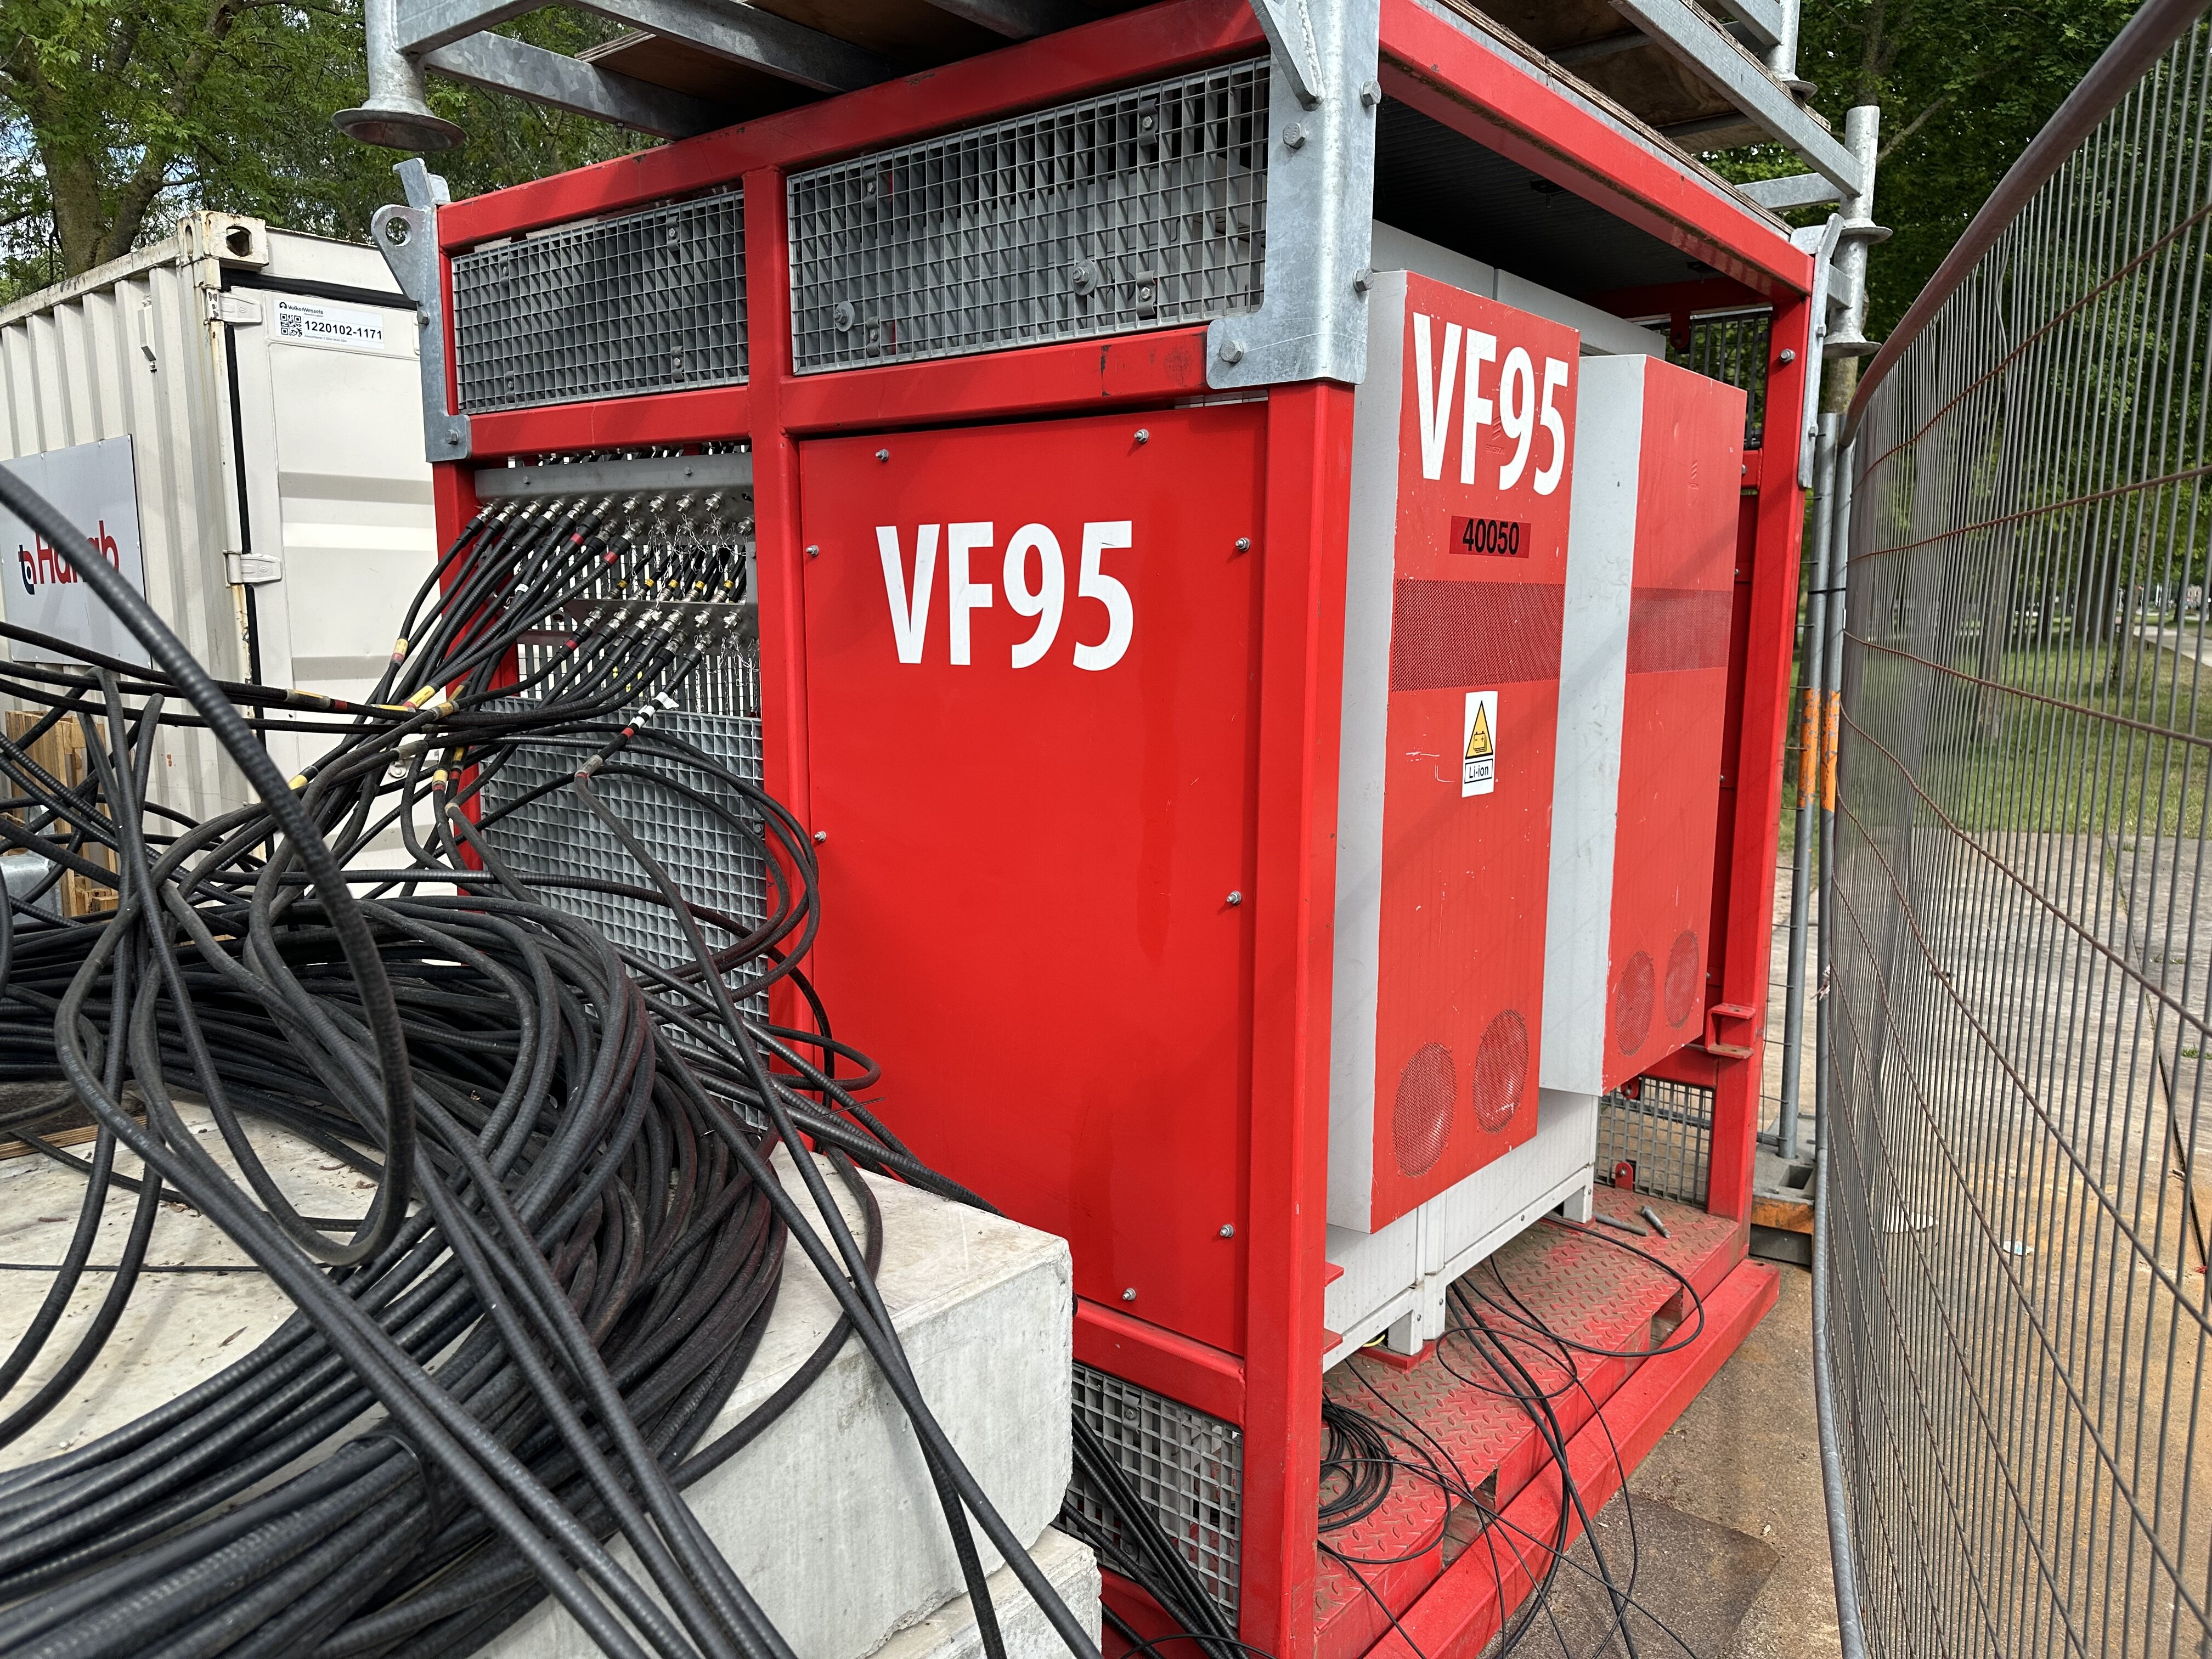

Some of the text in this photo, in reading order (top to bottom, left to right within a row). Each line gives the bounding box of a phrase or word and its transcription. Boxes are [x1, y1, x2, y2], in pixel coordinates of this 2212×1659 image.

[288, 305, 323, 314] VolkerWessels
[304, 320, 382, 340] 1220102-1171
[1413, 312, 1569, 495] VF95
[35, 520, 119, 584] Hab
[1463, 518, 1520, 555] 40050
[876, 521, 1133, 671] VF95
[1469, 765, 1489, 778] Li-ion
